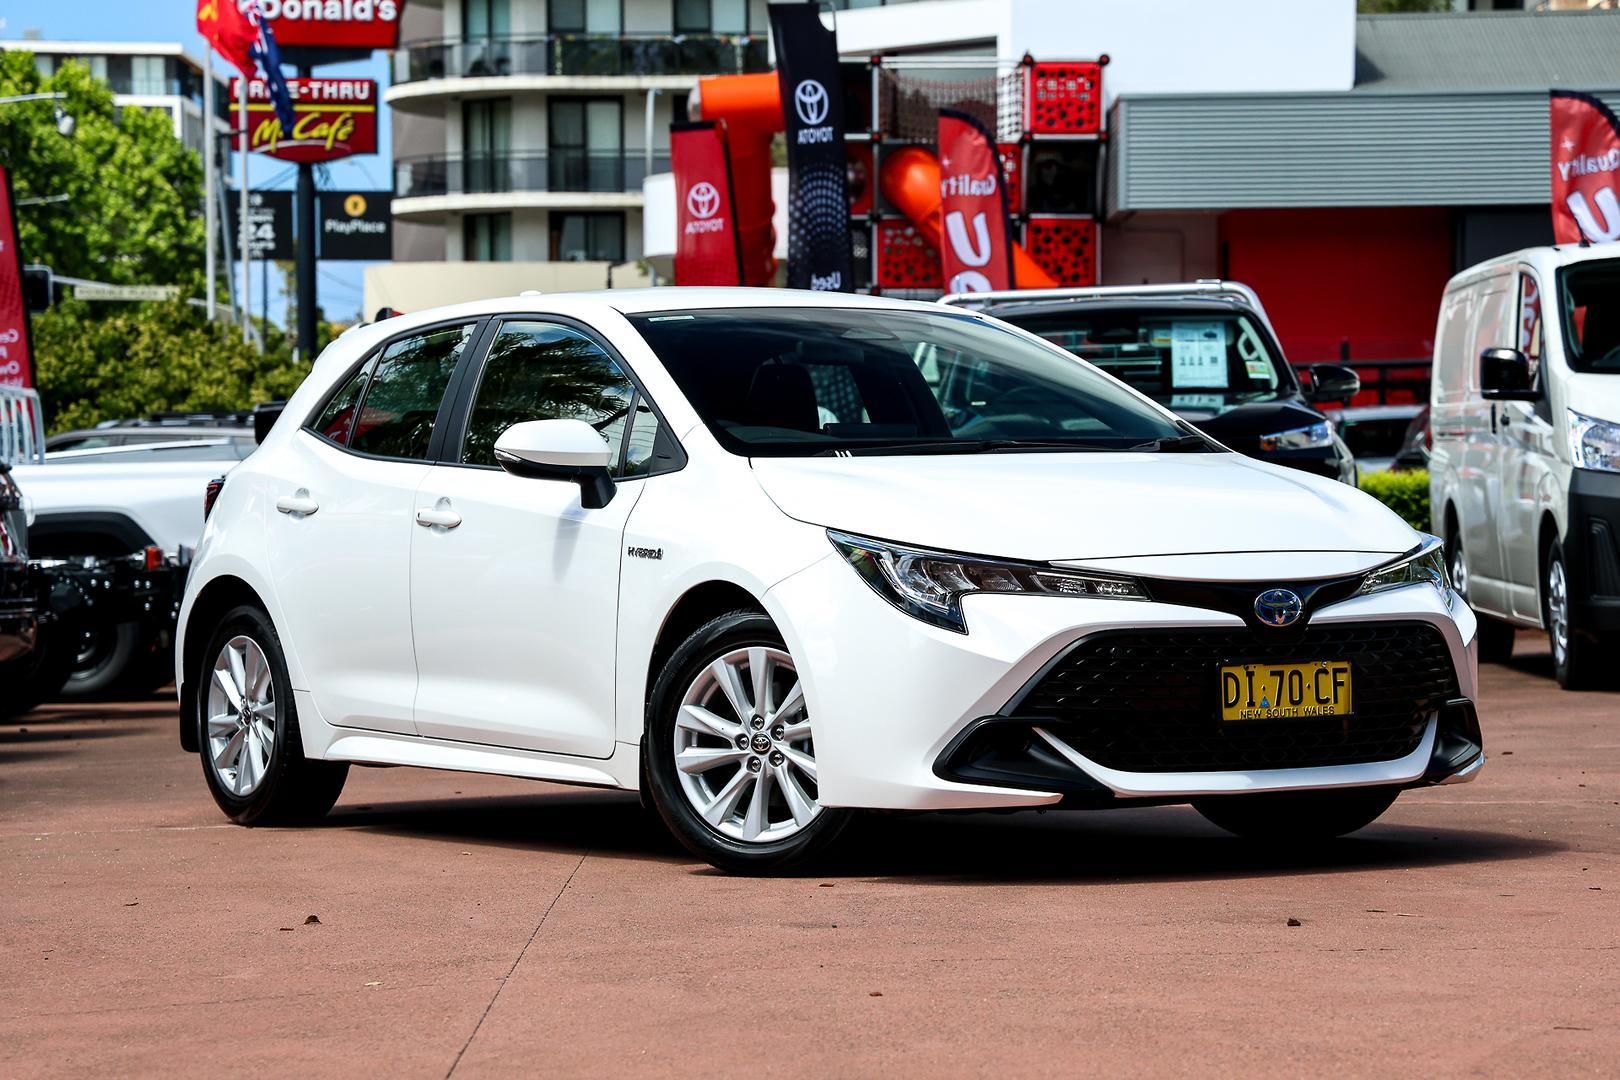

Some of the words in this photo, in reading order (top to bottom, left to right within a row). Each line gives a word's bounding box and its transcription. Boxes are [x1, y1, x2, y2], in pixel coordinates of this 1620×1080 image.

[238, 0, 398, 21] Donald's
[325, 219, 386, 235] PlayPlace
[1240, 709, 1261, 719] NEW
[1266, 707, 1299, 718] SOUTH
[1303, 705, 1335, 716] WALES
